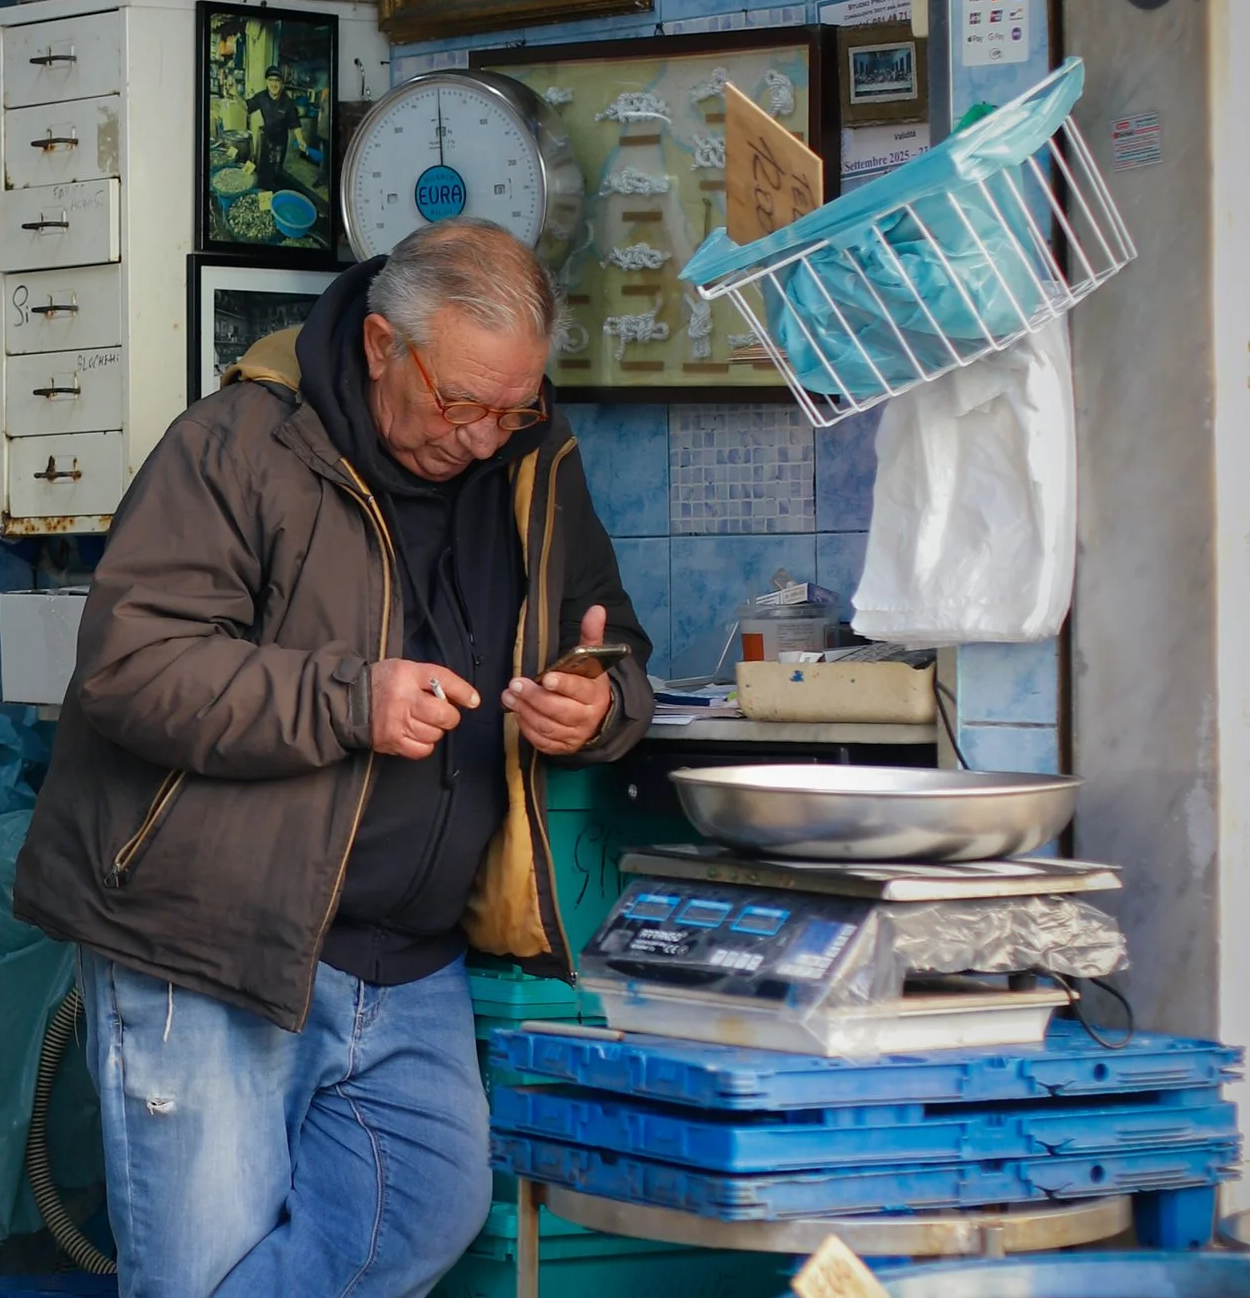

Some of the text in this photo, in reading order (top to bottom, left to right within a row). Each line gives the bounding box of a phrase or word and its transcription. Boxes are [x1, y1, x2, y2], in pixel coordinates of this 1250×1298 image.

[844, 155, 888, 173] Settembre
[889, 149, 910, 165] 2025
[418, 184, 462, 206] EURA
